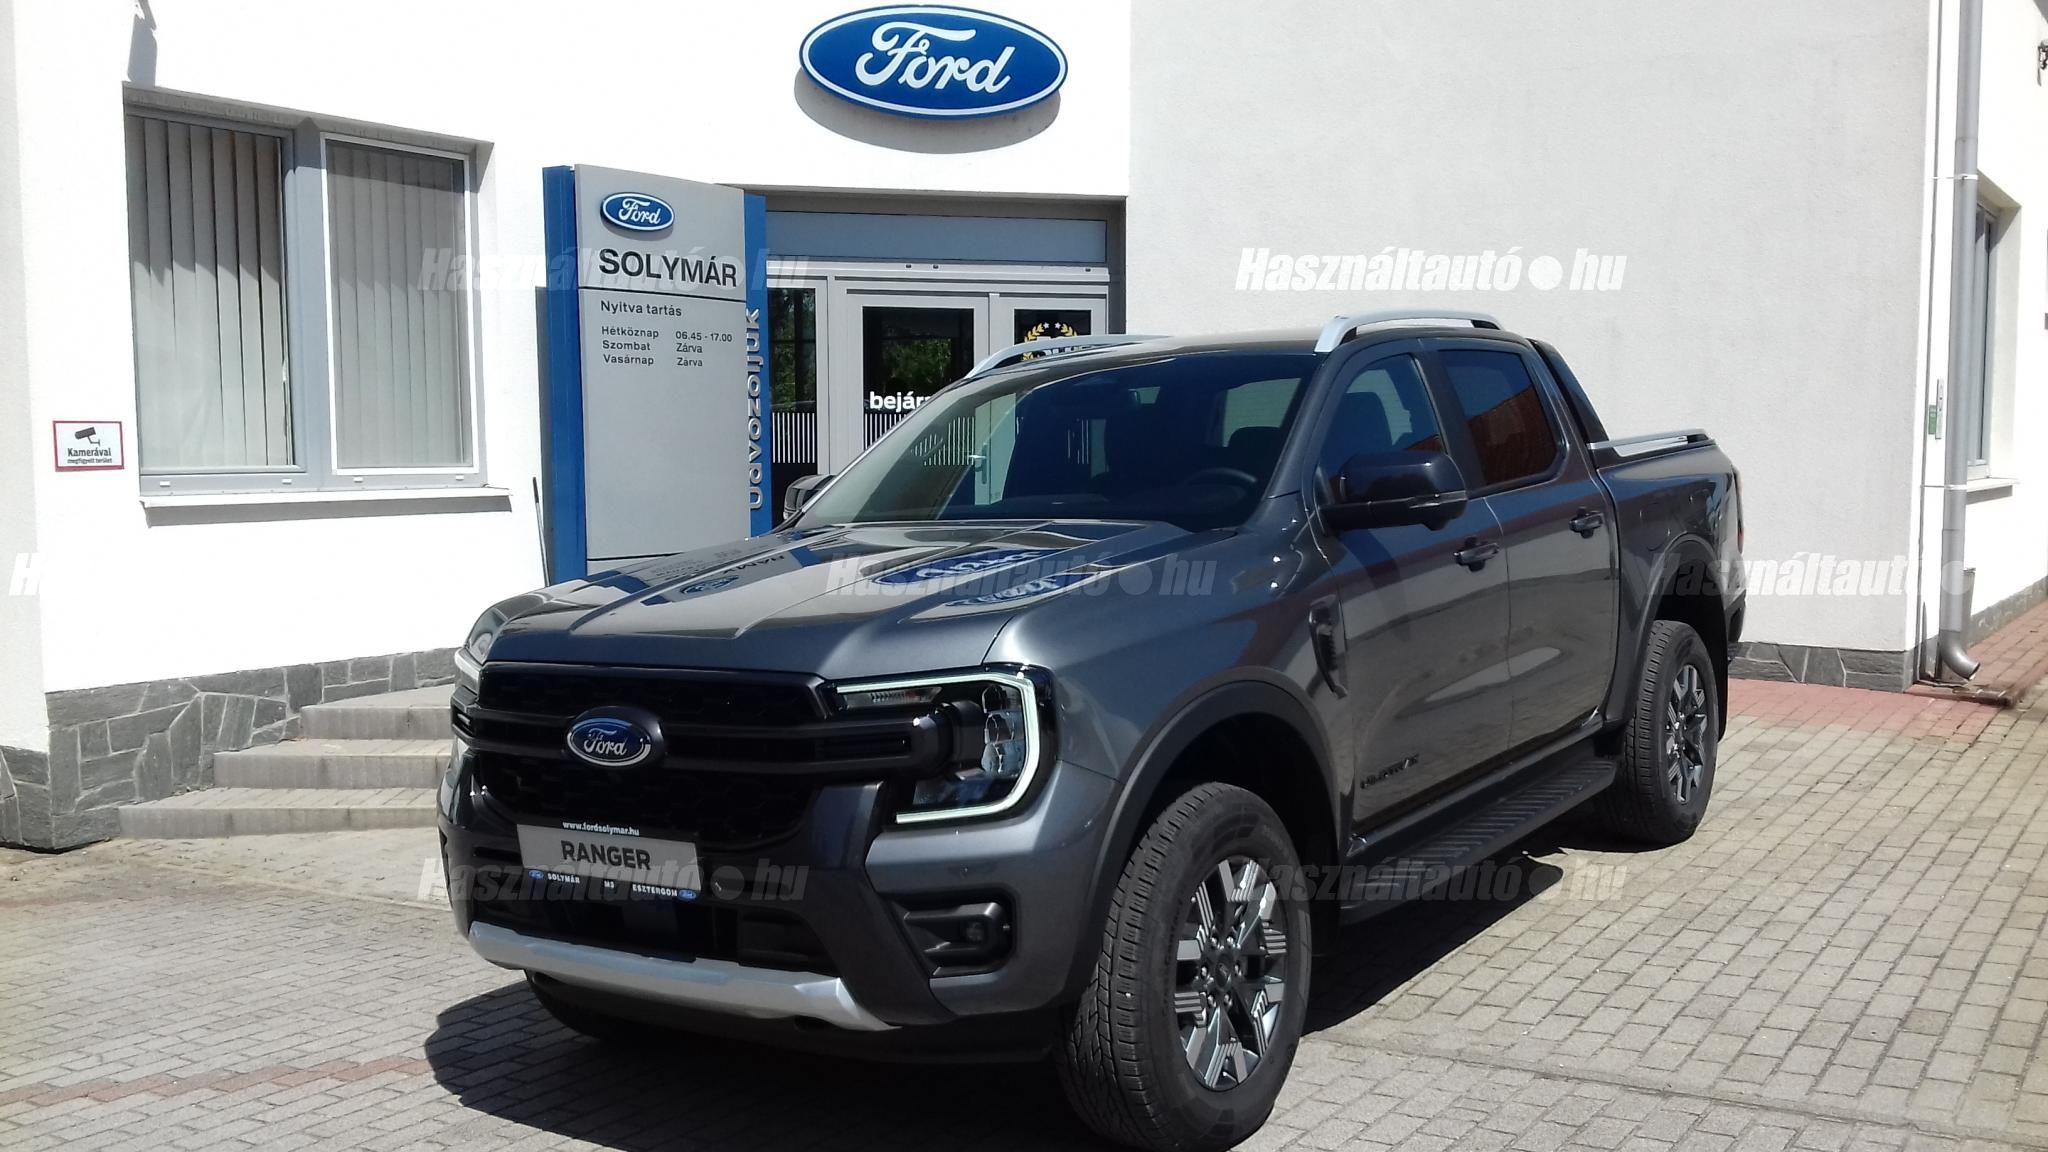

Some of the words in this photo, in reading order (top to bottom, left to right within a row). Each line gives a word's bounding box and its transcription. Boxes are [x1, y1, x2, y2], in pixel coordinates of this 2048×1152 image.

[855, 21, 1016, 94] Ford
[618, 198, 661, 225] Ford
[599, 248, 737, 287] SOLYMÁR
[600, 300, 643, 315] Nyitva
[646, 304, 682, 317] tartás
[601, 325, 660, 340] Hétköznap
[675, 331, 702, 341] 06.45
[710, 333, 733, 343] 17.00
[602, 340, 651, 351] Szombat
[603, 354, 655, 367] Vasárnap
[67, 447, 112, 457] Kamerával
[583, 727, 628, 755] Ford
[562, 821, 640, 836] www.fordsolymar.hu
[561, 840, 651, 870] RANGER
[547, 872, 580, 884] SOLYMÁR
[632, 883, 678, 897] ESZTERGOM
